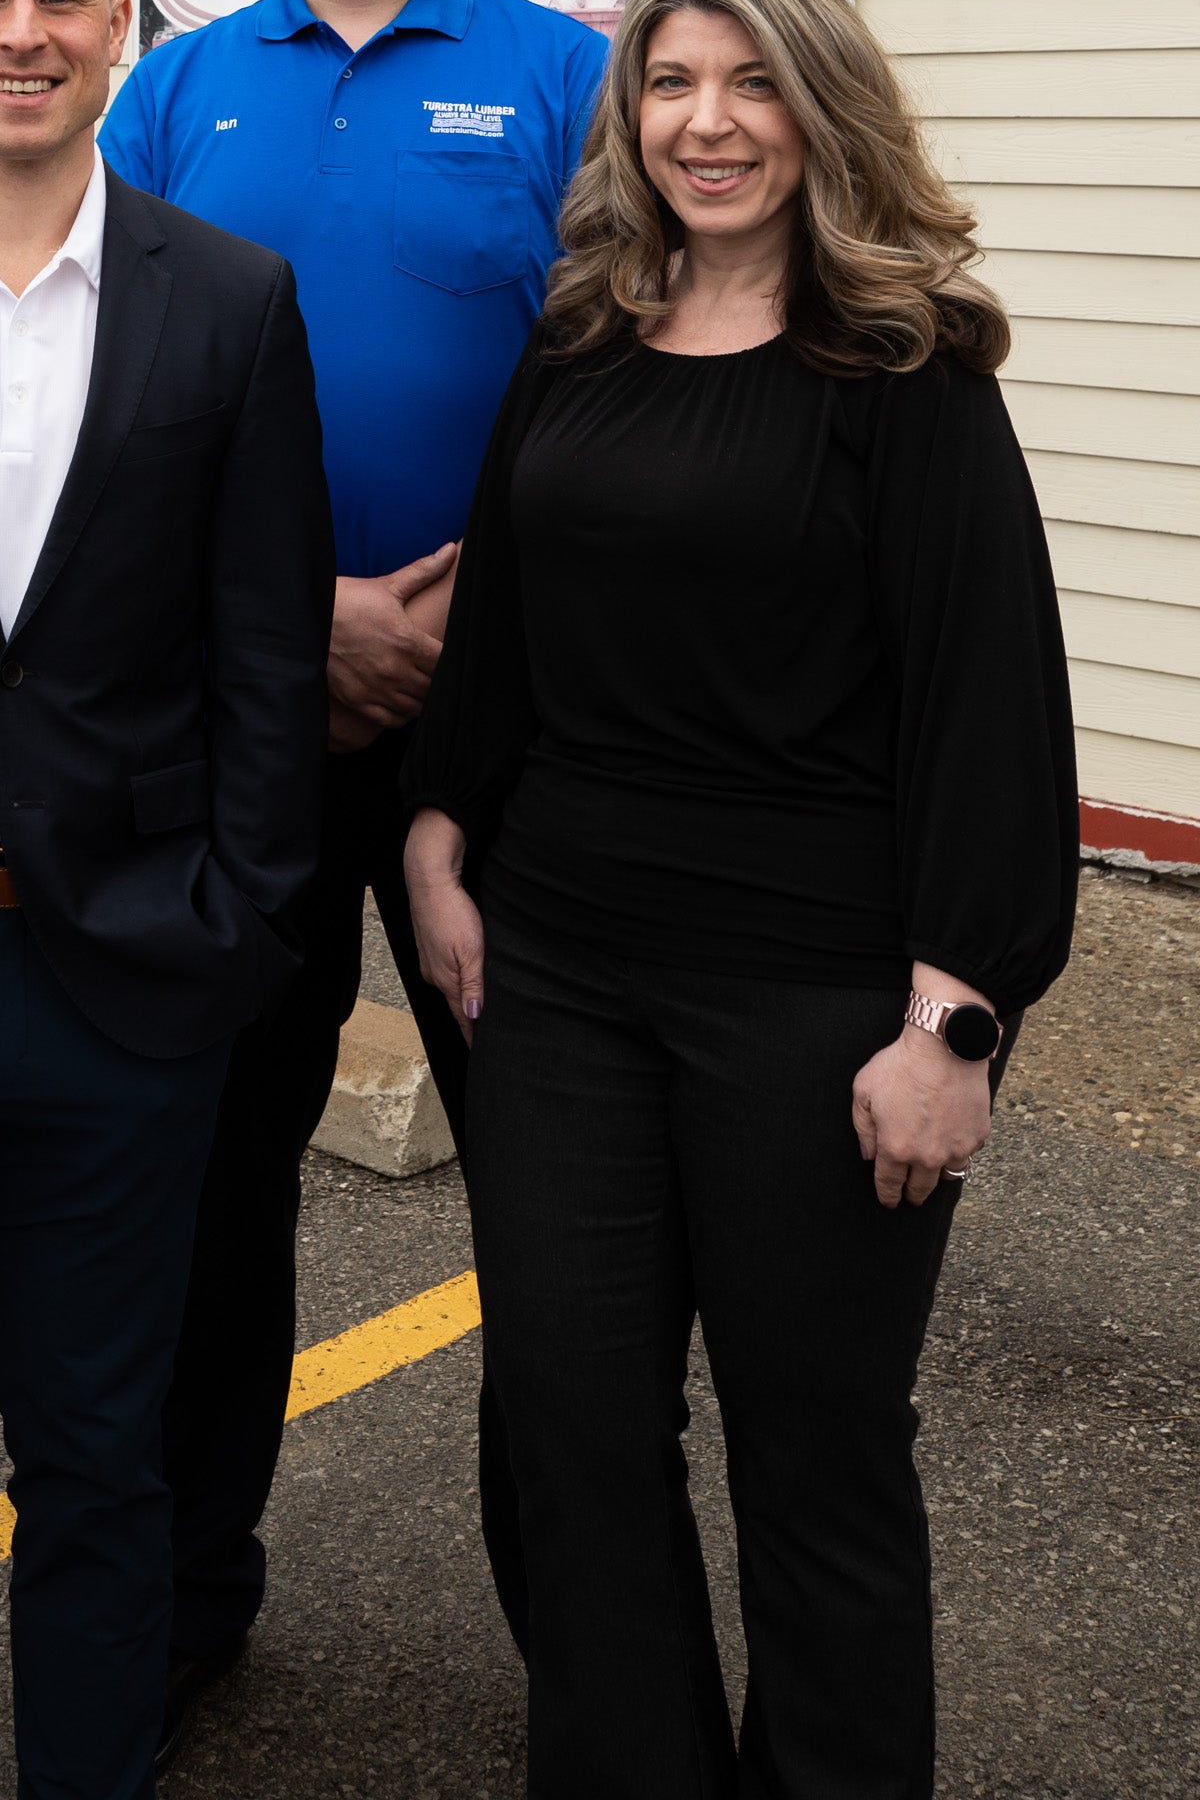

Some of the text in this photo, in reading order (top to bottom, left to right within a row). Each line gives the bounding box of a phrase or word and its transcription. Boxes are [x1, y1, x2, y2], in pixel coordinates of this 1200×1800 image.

[422, 101, 515, 115] TURKSTRA LUMBER
[215, 118, 237, 132] Ian
[430, 126, 504, 138] turkstralumber.com
